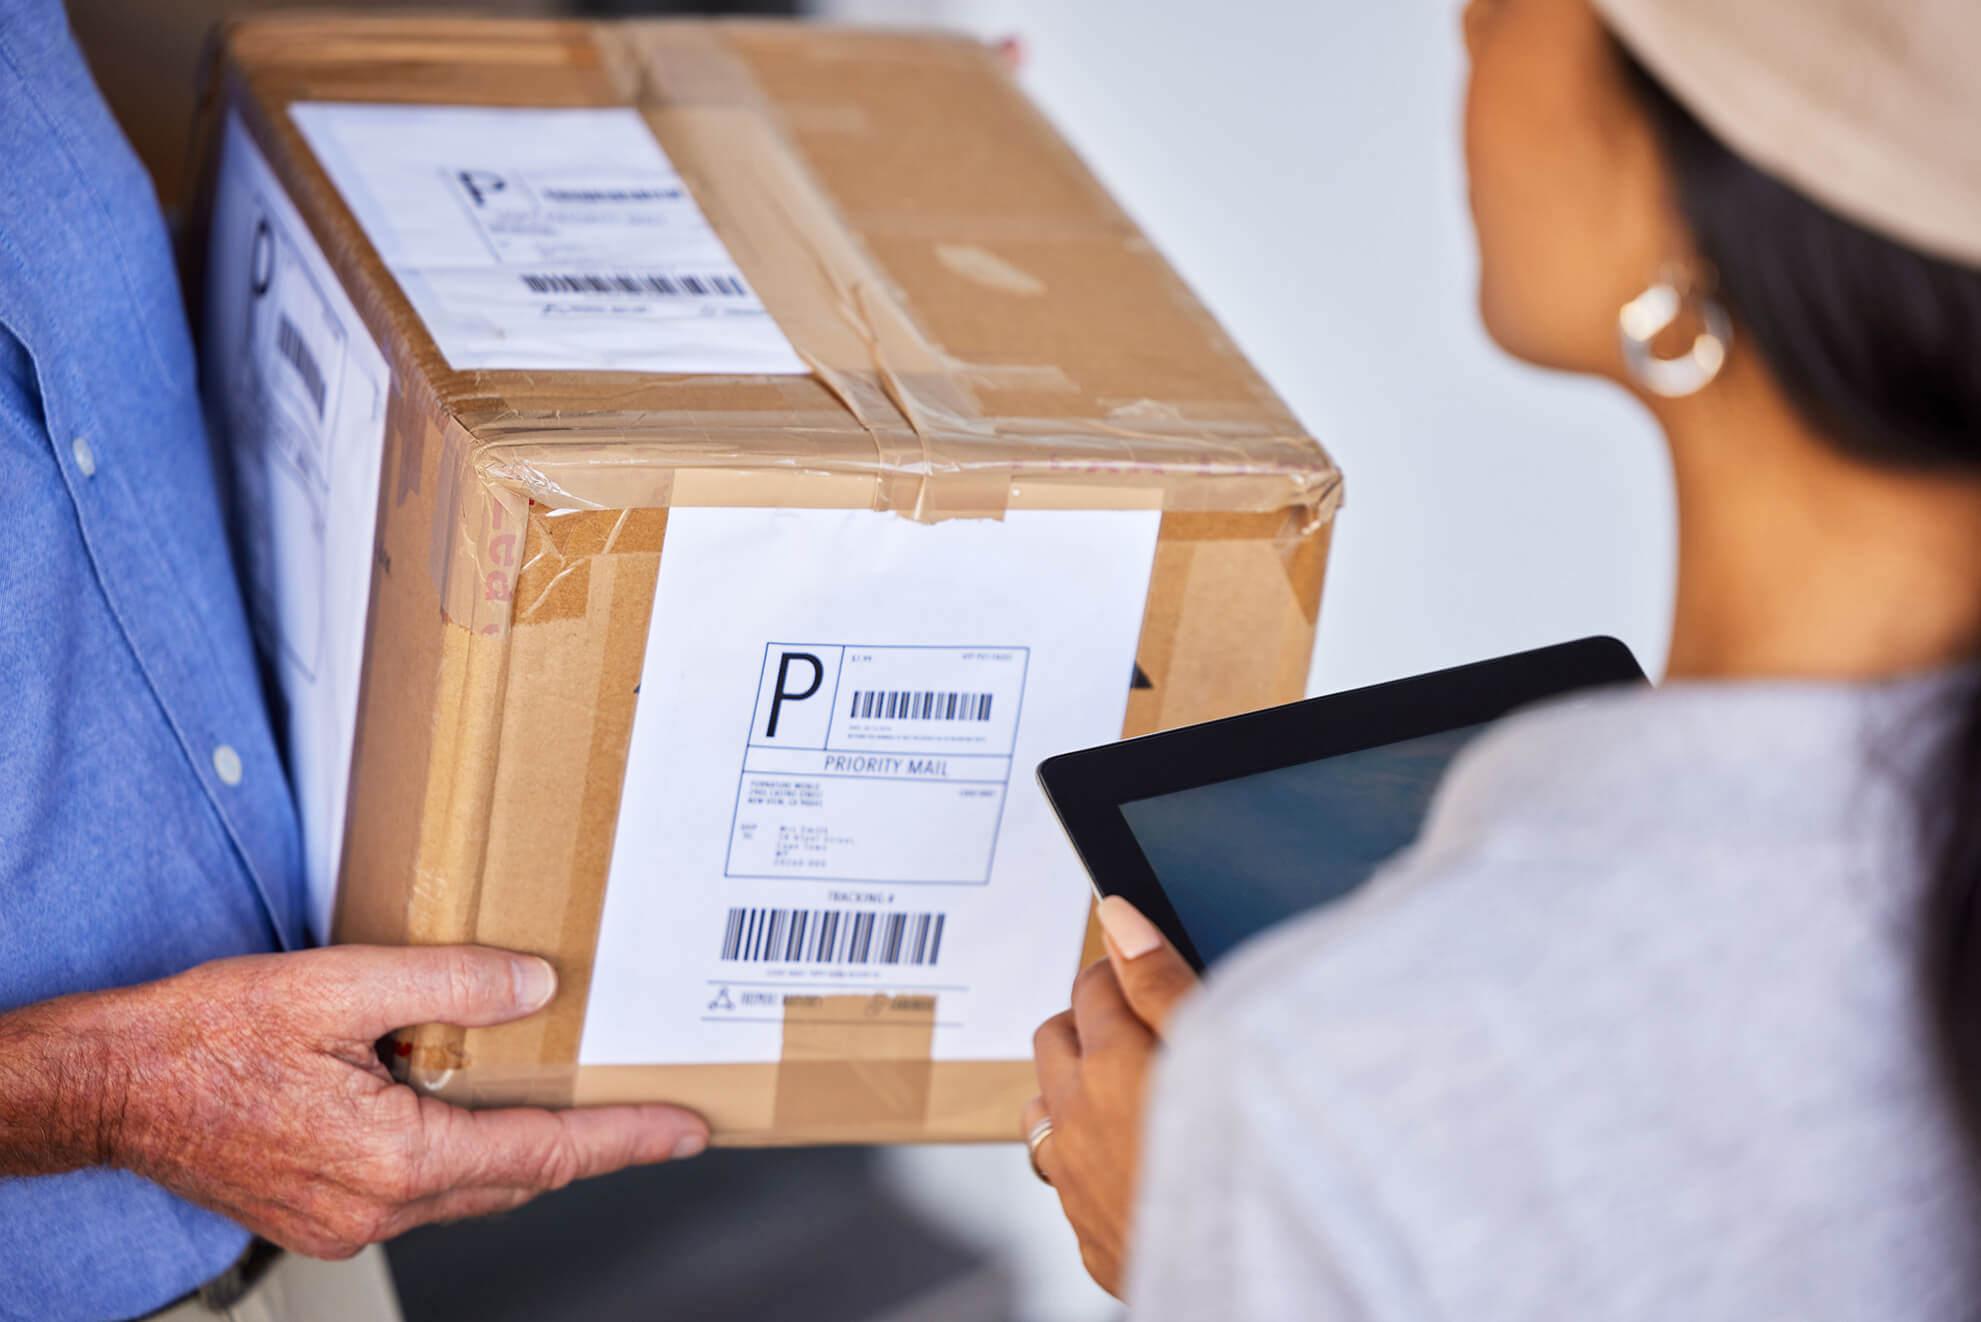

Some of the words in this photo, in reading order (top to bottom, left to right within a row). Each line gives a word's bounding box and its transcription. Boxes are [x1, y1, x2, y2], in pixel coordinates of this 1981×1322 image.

[765, 651, 825, 738] P
[824, 755, 904, 775] PRIORITY
[908, 759, 949, 777] MAIL
[827, 890, 884, 904] TRACKING
[887, 892, 895, 904] #
